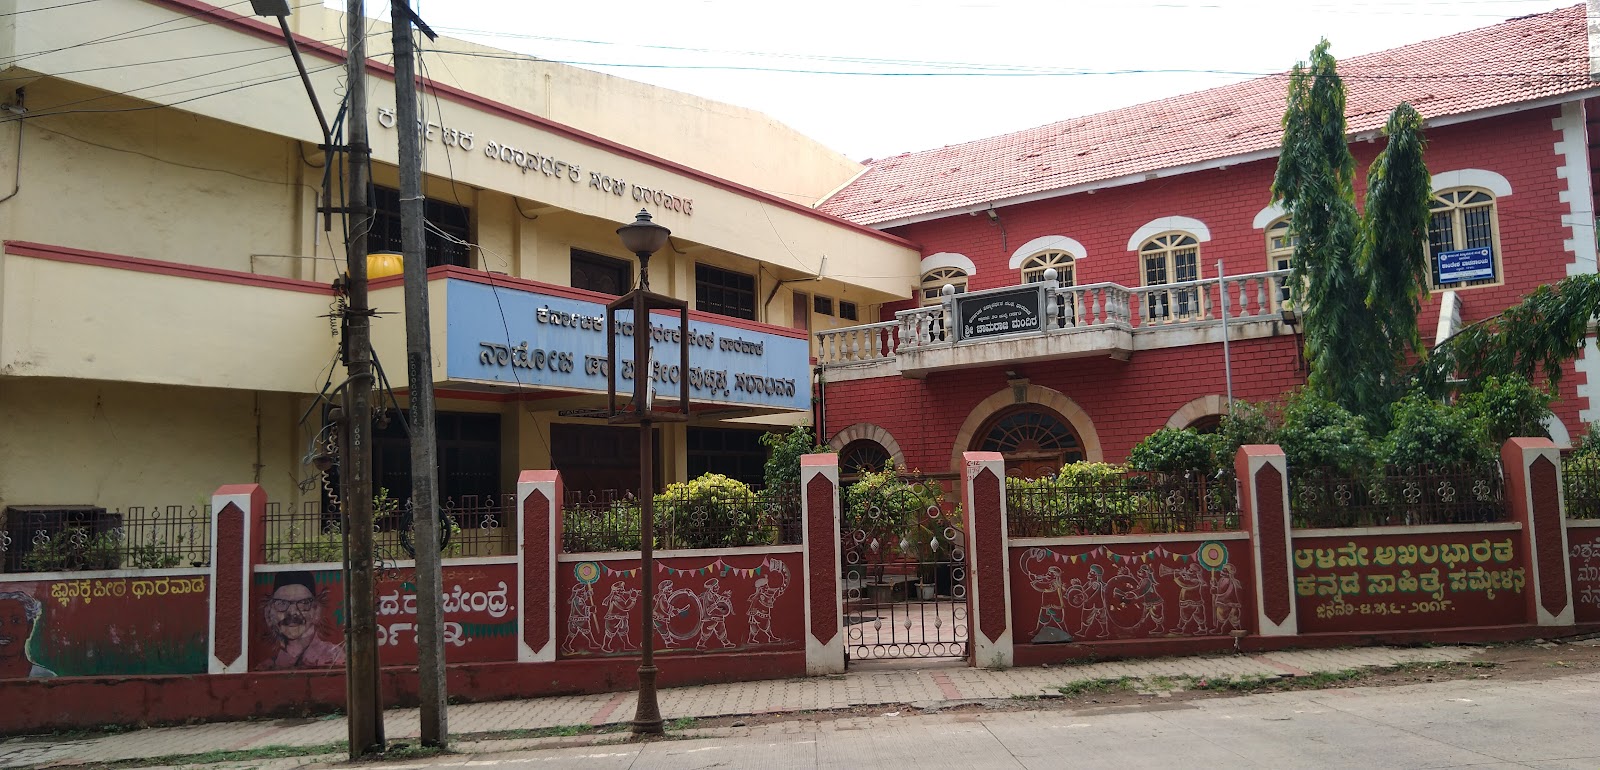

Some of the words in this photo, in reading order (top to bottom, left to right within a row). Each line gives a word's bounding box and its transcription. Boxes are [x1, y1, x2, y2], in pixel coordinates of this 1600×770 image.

[485, 139, 582, 183] ವಿದ್ಯಾವರ್ಧಕ
[589, 171, 626, 197] ಸಂಘ
[631, 184, 694, 216] ಧಾರವಾಡ
[536, 304, 604, 332] ಕರ್ನಾಟಕ
[719, 336, 764, 356] ಧಾರವಾಡ
[964, 324, 974, 338] ಶ್ರೀ
[976, 320, 1009, 334] ಚಾಮರಾಜ
[1011, 315, 1038, 329] ಮಂದಿರ
[480, 340, 574, 373] ನಾಡೋಜ
[734, 372, 796, 398] ಸಭಾಭವನ
[1373, 537, 1514, 569] ಅಖಿಲಭಾರತ
[131, 576, 206, 600] ಧಾರವಾಡ
[1296, 572, 1360, 602] ಕನ್ನಡ
[1367, 567, 1445, 601] ಸಾಹಿತ್ಯ
[1448, 566, 1526, 600] ಸಮ್ಮೇಳನ
